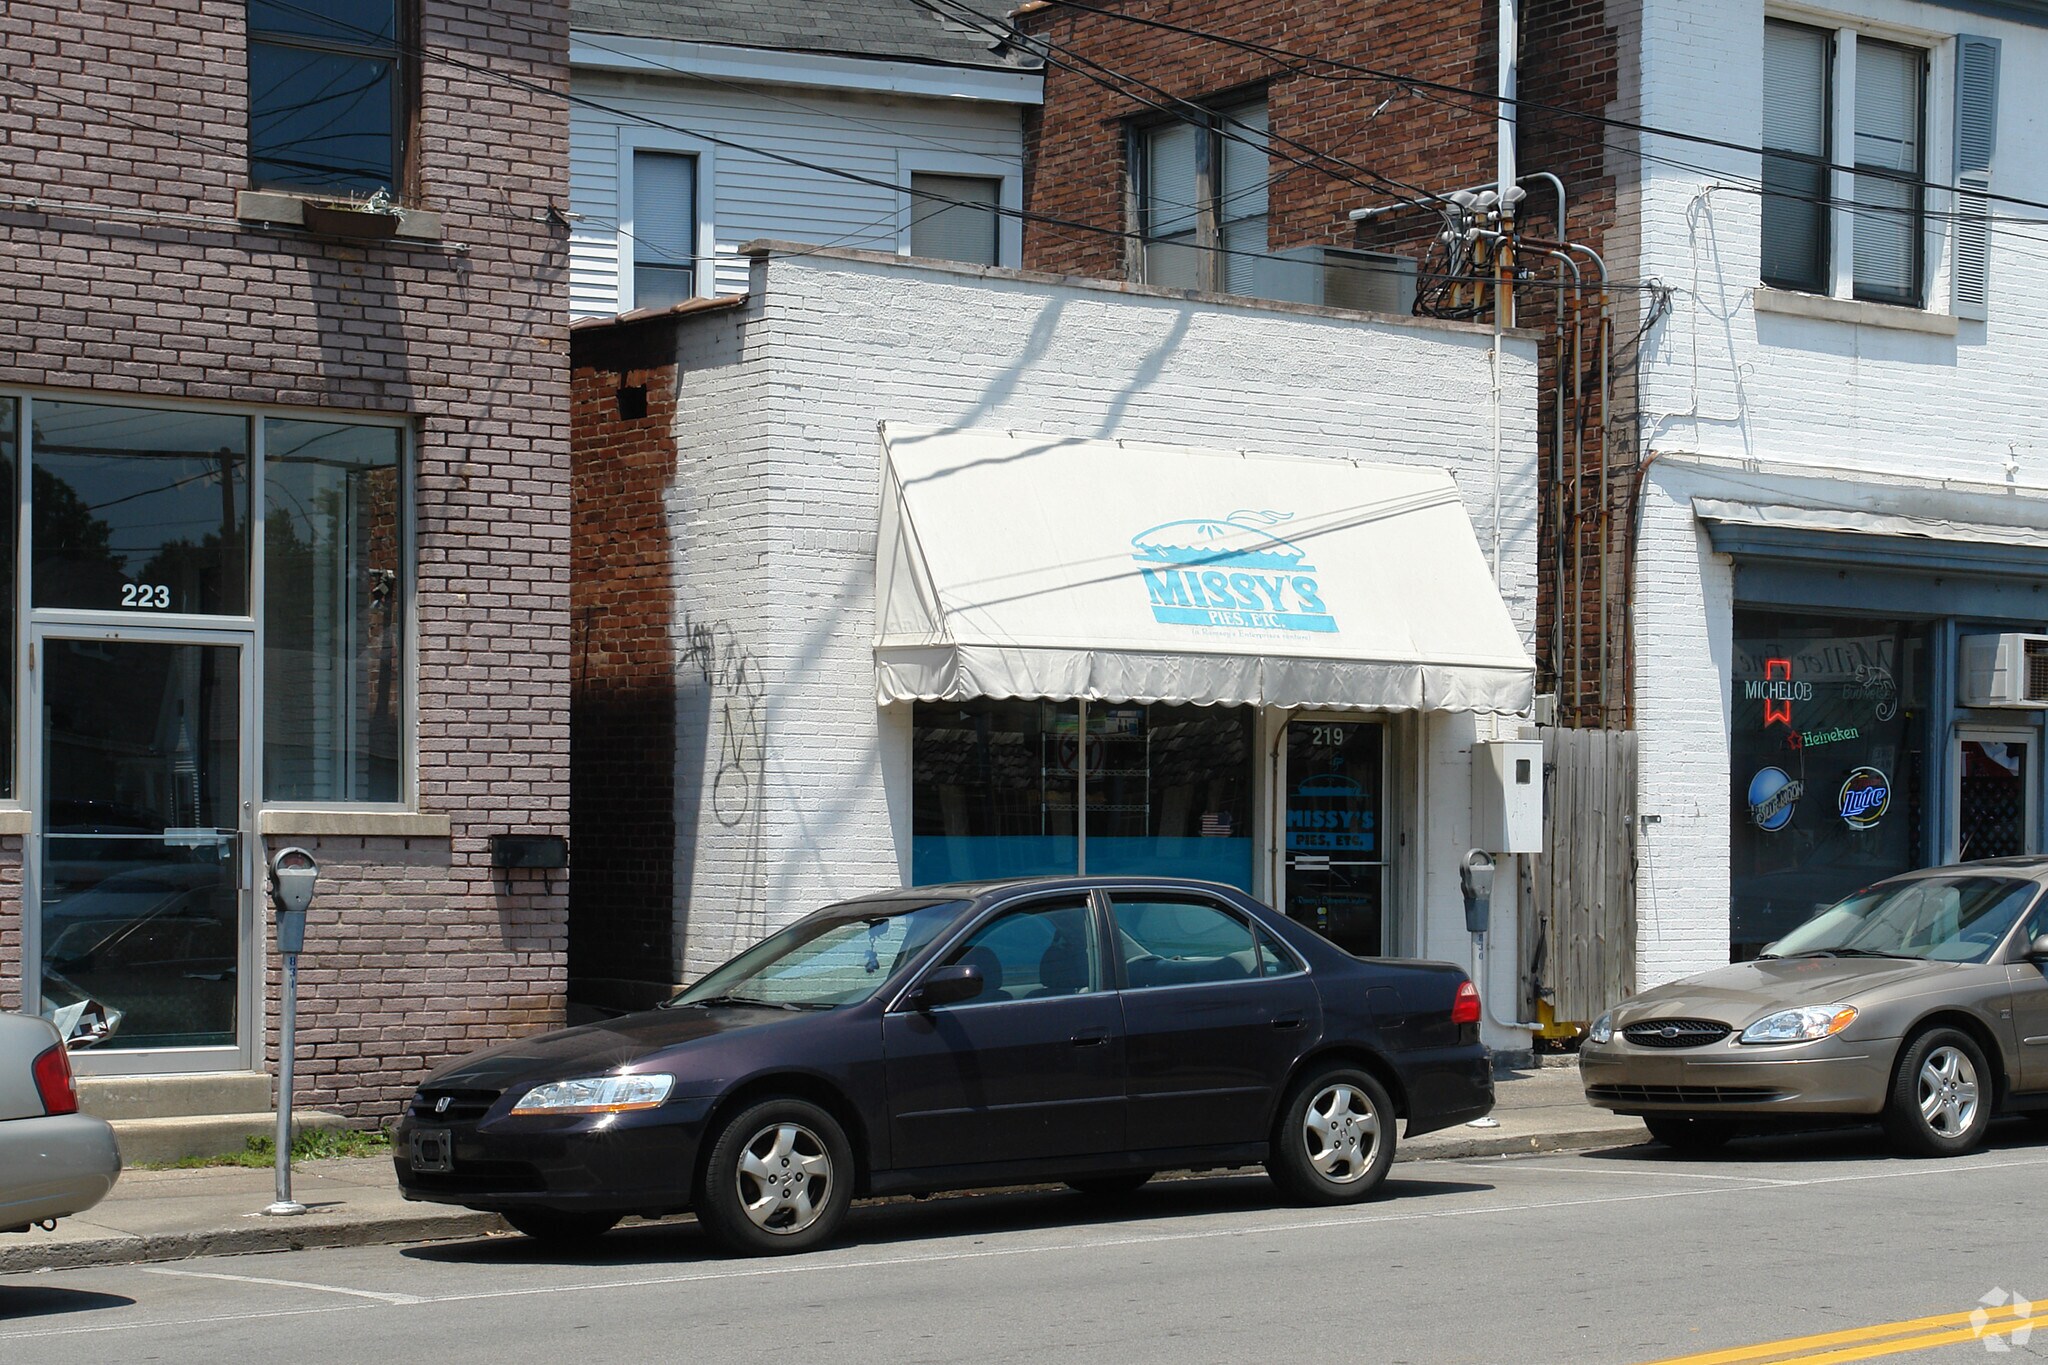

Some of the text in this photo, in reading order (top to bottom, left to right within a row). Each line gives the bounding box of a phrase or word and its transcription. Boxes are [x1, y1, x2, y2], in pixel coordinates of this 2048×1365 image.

[121, 583, 170, 608] 223
[1137, 567, 1327, 614] MISSY'S
[1249, 612, 1287, 628] ETC.
[1744, 680, 1813, 701] MICHELOB
[1312, 727, 1344, 745] 219
[1802, 727, 1859, 747] Heineken
[1840, 786, 1887, 817] Lite
[1286, 810, 1374, 828] MISSY'S
[1335, 834, 1364, 846] ETC.
